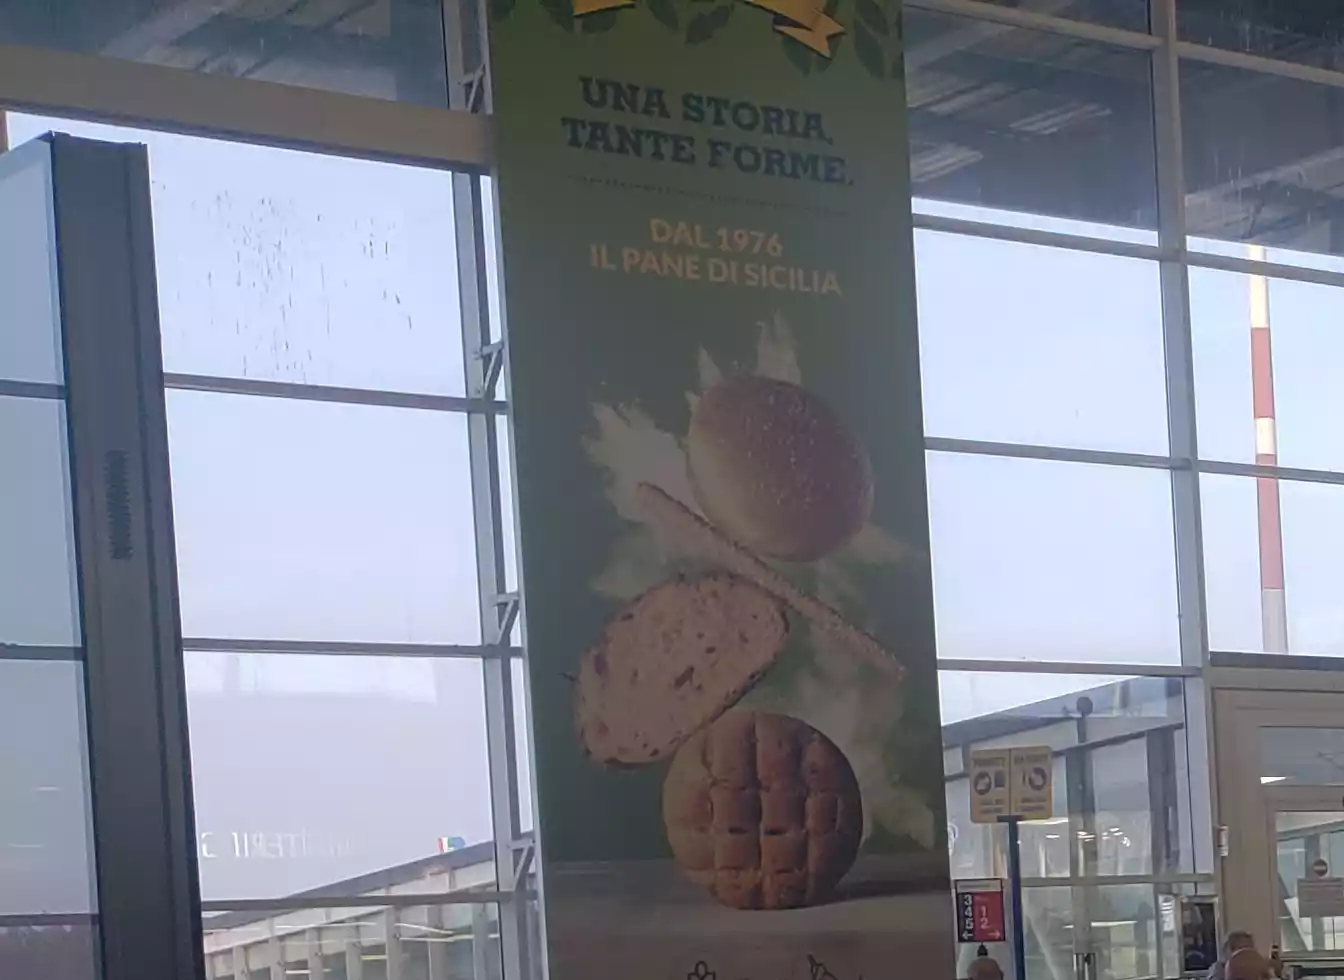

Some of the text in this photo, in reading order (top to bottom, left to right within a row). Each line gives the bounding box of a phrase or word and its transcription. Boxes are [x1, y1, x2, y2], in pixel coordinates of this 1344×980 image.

[579, 75, 833, 145] UNA STORIA,
[561, 117, 854, 185] TANTE FORME.
[650, 217, 783, 257] DAL 1976
[590, 244, 842, 295] IL PANE DI SICILIA
[964, 894, 973, 906] 3
[964, 906, 973, 917] 4
[980, 917, 991, 930] 2
